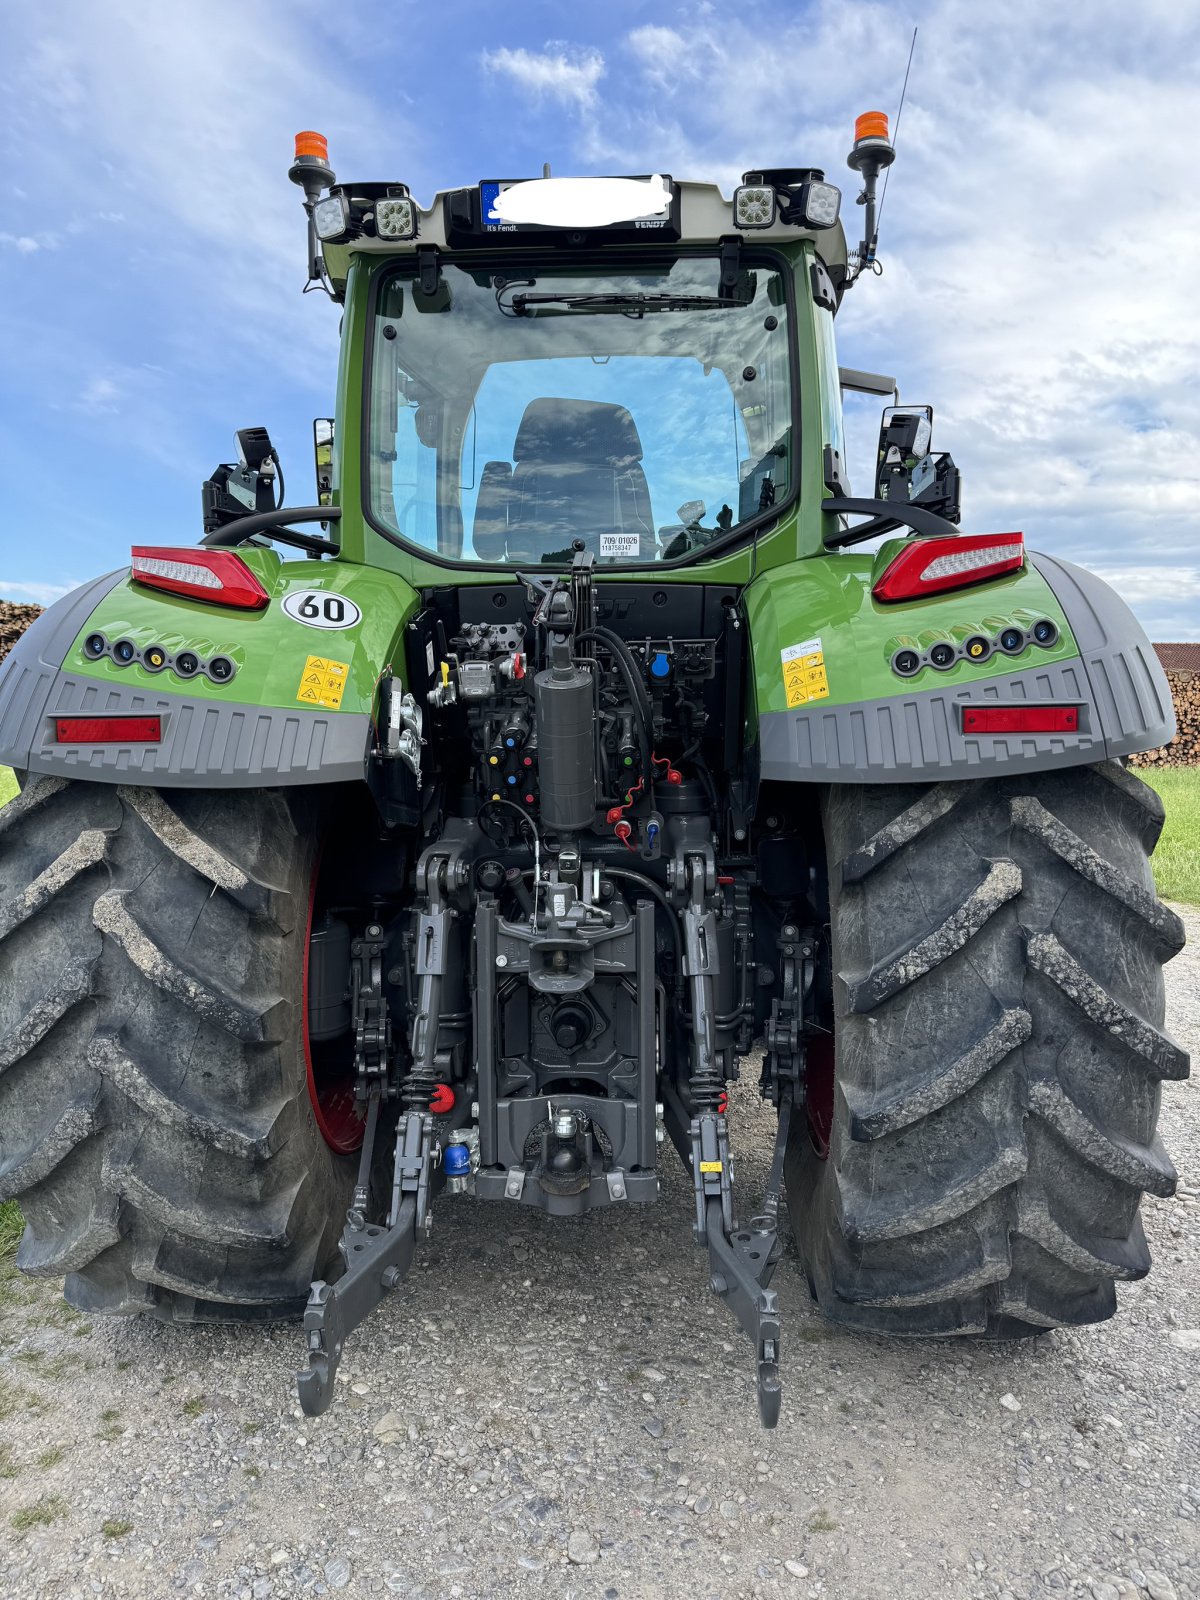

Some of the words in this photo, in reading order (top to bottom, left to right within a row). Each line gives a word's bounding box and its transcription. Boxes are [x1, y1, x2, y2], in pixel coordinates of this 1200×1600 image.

[487, 224, 497, 232] It's
[498, 224, 518, 232] Fendt.
[635, 221, 666, 229] FENDT
[298, 595, 344, 622] 60
